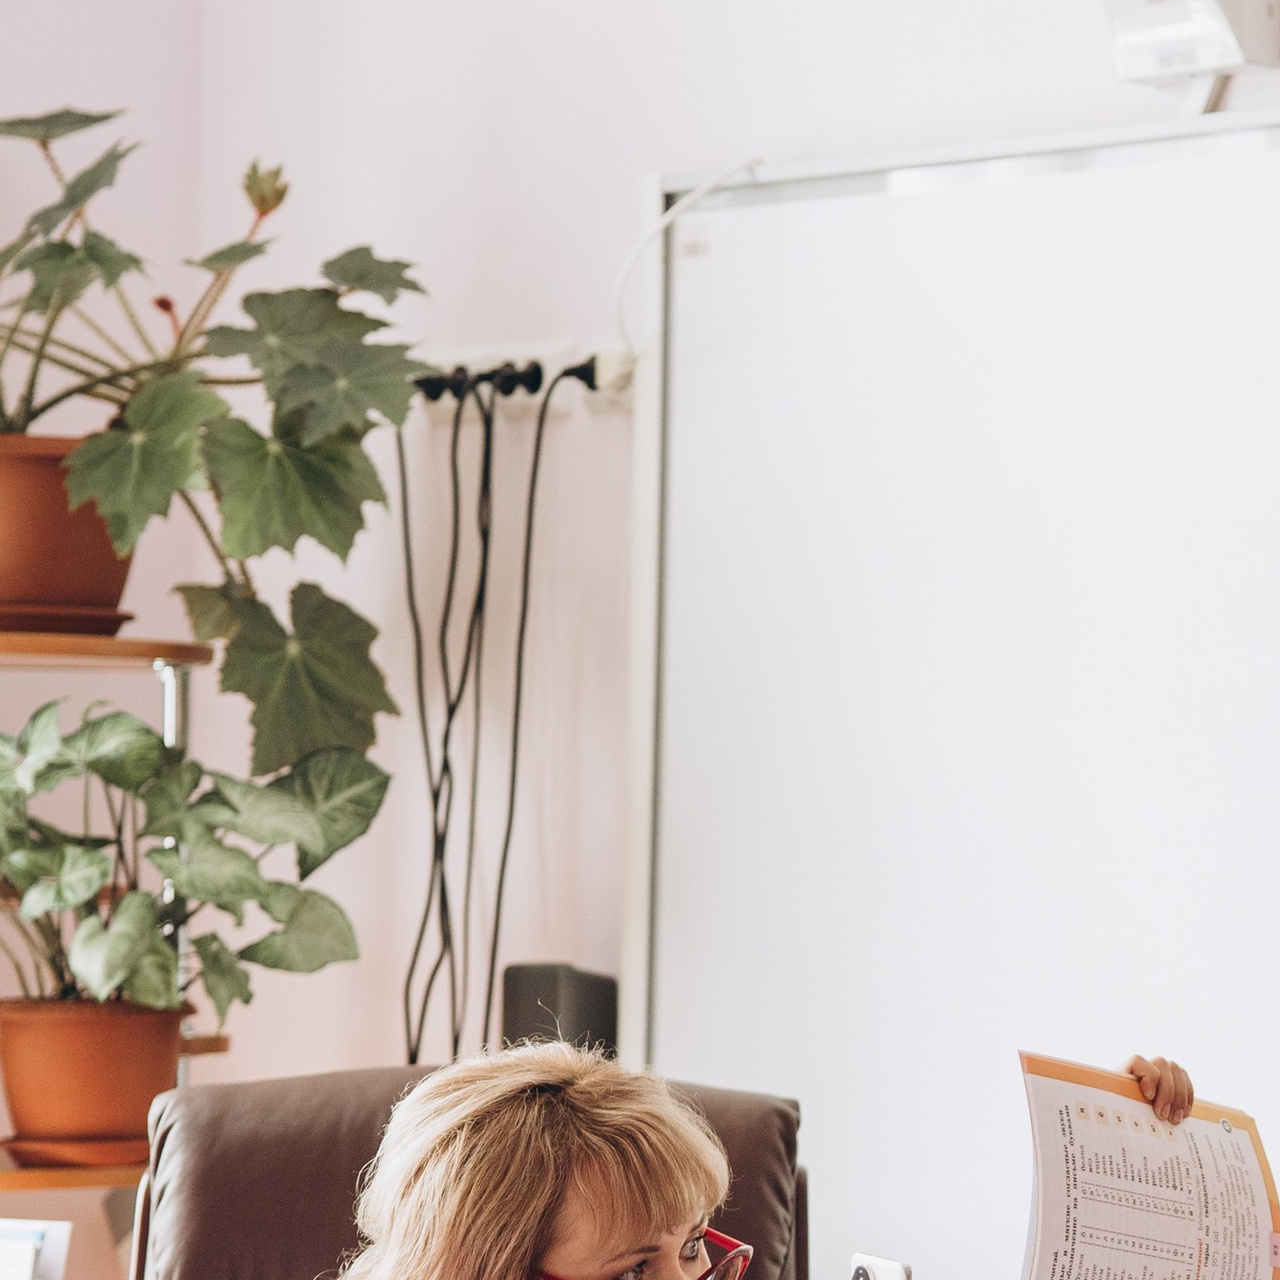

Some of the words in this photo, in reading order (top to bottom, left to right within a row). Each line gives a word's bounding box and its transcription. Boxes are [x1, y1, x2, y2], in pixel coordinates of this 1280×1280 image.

[1065, 1105, 1074, 1146] буквами
[1073, 1198, 1077, 1209] на
[1205, 1225, 1209, 1236] по
